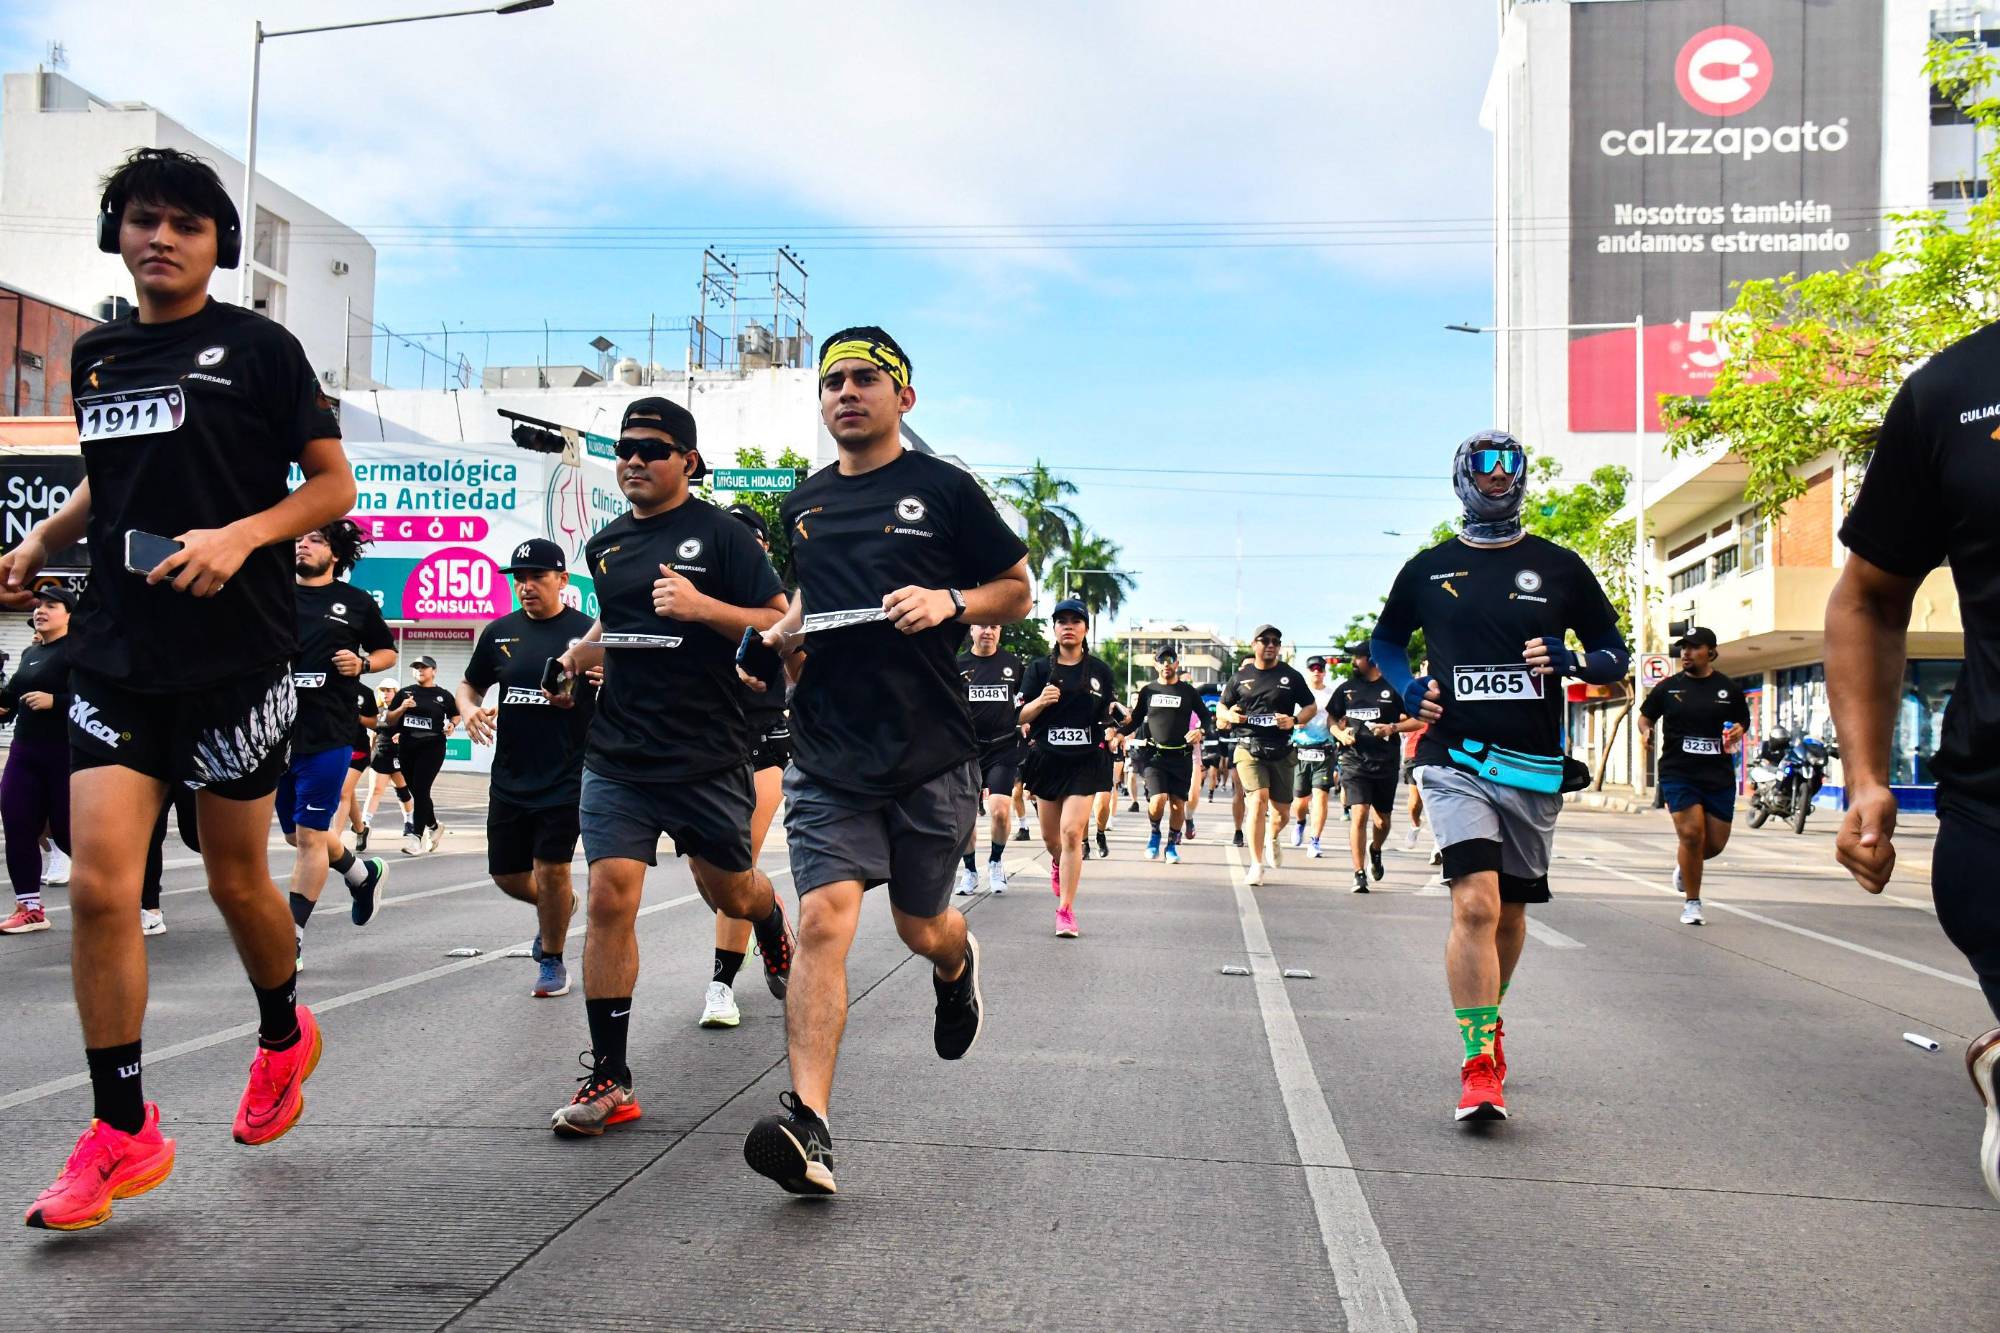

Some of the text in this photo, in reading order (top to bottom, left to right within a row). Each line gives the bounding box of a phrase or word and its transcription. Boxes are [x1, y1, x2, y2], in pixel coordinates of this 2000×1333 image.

[1600, 120, 1848, 160] calzzapato
[1614, 200, 1831, 225] Nosotros también
[1597, 229, 1850, 253] andamos estrenando
[88, 403, 158, 434] 1911
[352, 459, 517, 487] ermatológica
[716, 476, 791, 488] MIGUEL HIDALGO
[6, 476, 71, 517] Súp
[396, 487, 516, 510] Antiedad
[372, 517, 474, 539] EGÓN
[419, 559, 492, 600] $150
[415, 600, 494, 614] CONSULTA
[408, 630, 469, 639] DERMATOLÓGICA
[971, 689, 999, 698] 3048
[1458, 674, 1523, 695] 0465
[1050, 730, 1082, 741] 3432
[1685, 740, 1712, 751] 3233
